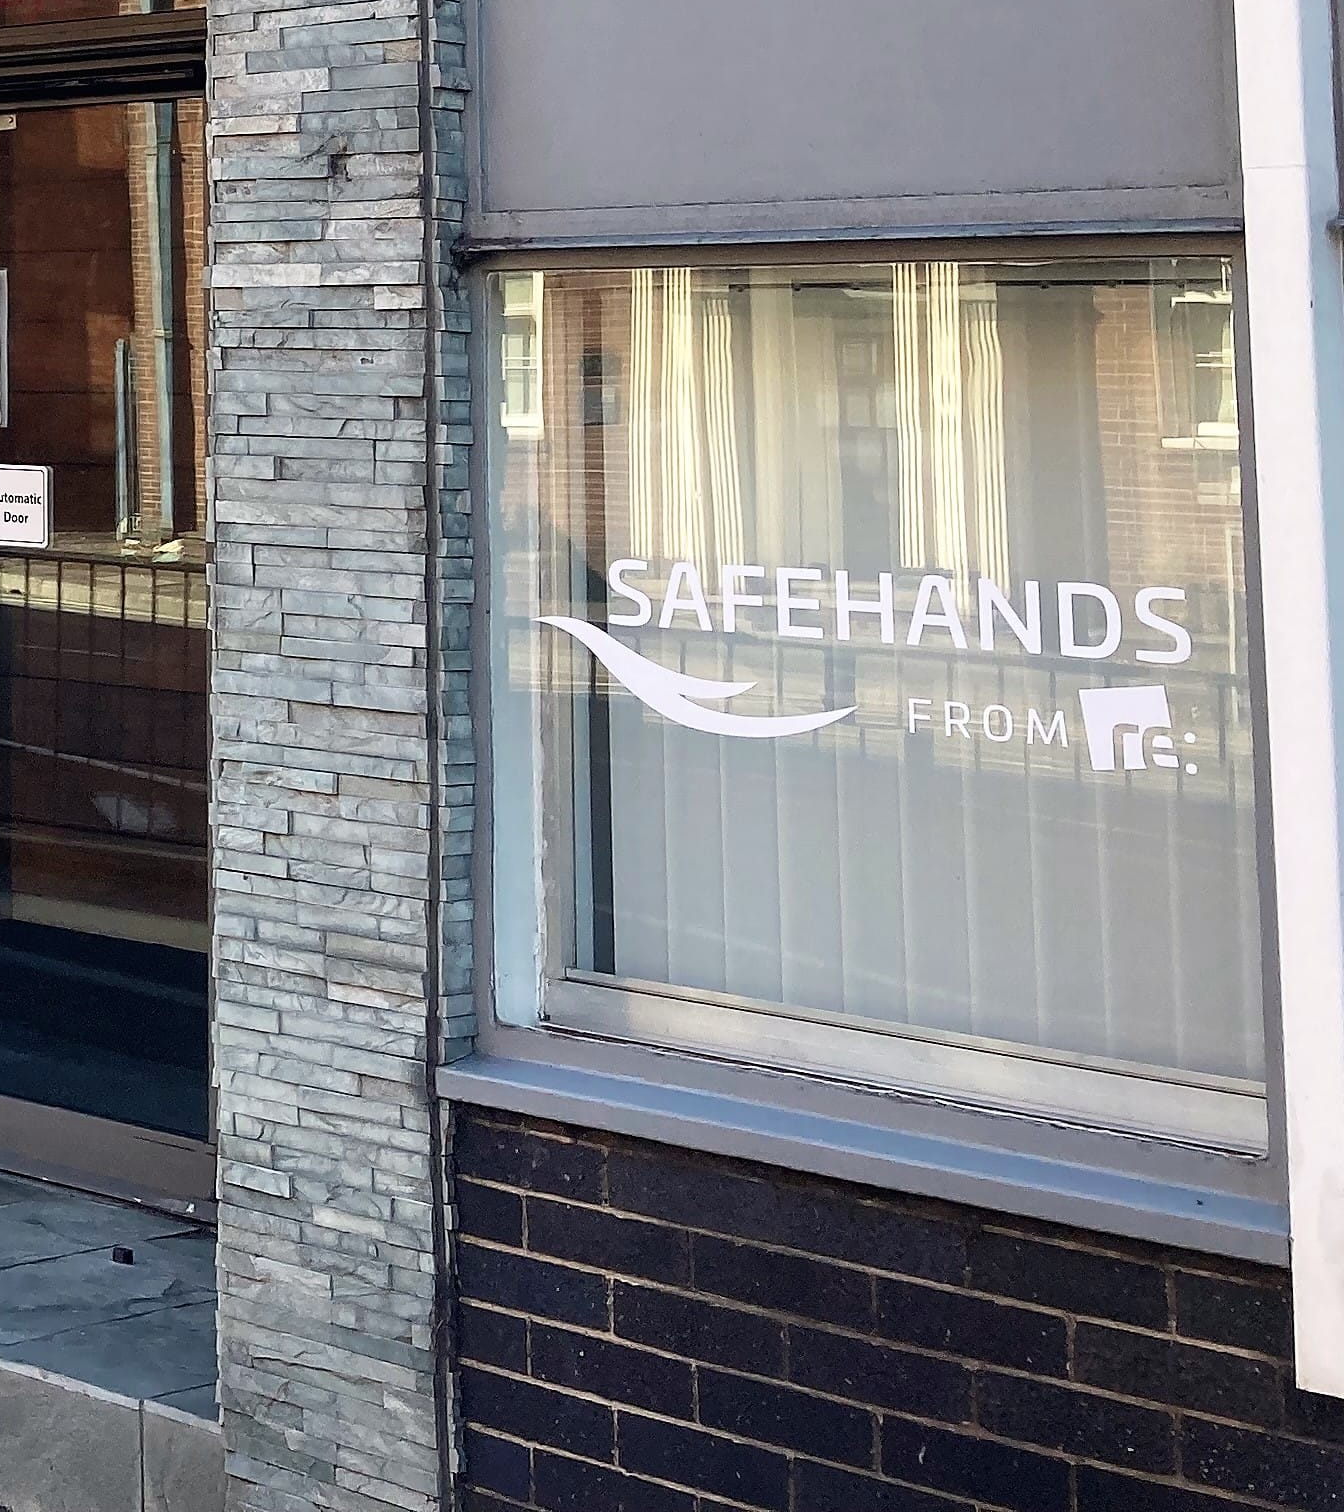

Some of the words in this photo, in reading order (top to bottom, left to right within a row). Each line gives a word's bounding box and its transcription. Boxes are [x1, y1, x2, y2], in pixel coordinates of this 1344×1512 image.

[3, 511, 29, 524] Door
[608, 557, 1194, 665] SAFEHANDS
[907, 697, 1069, 749] FROM
